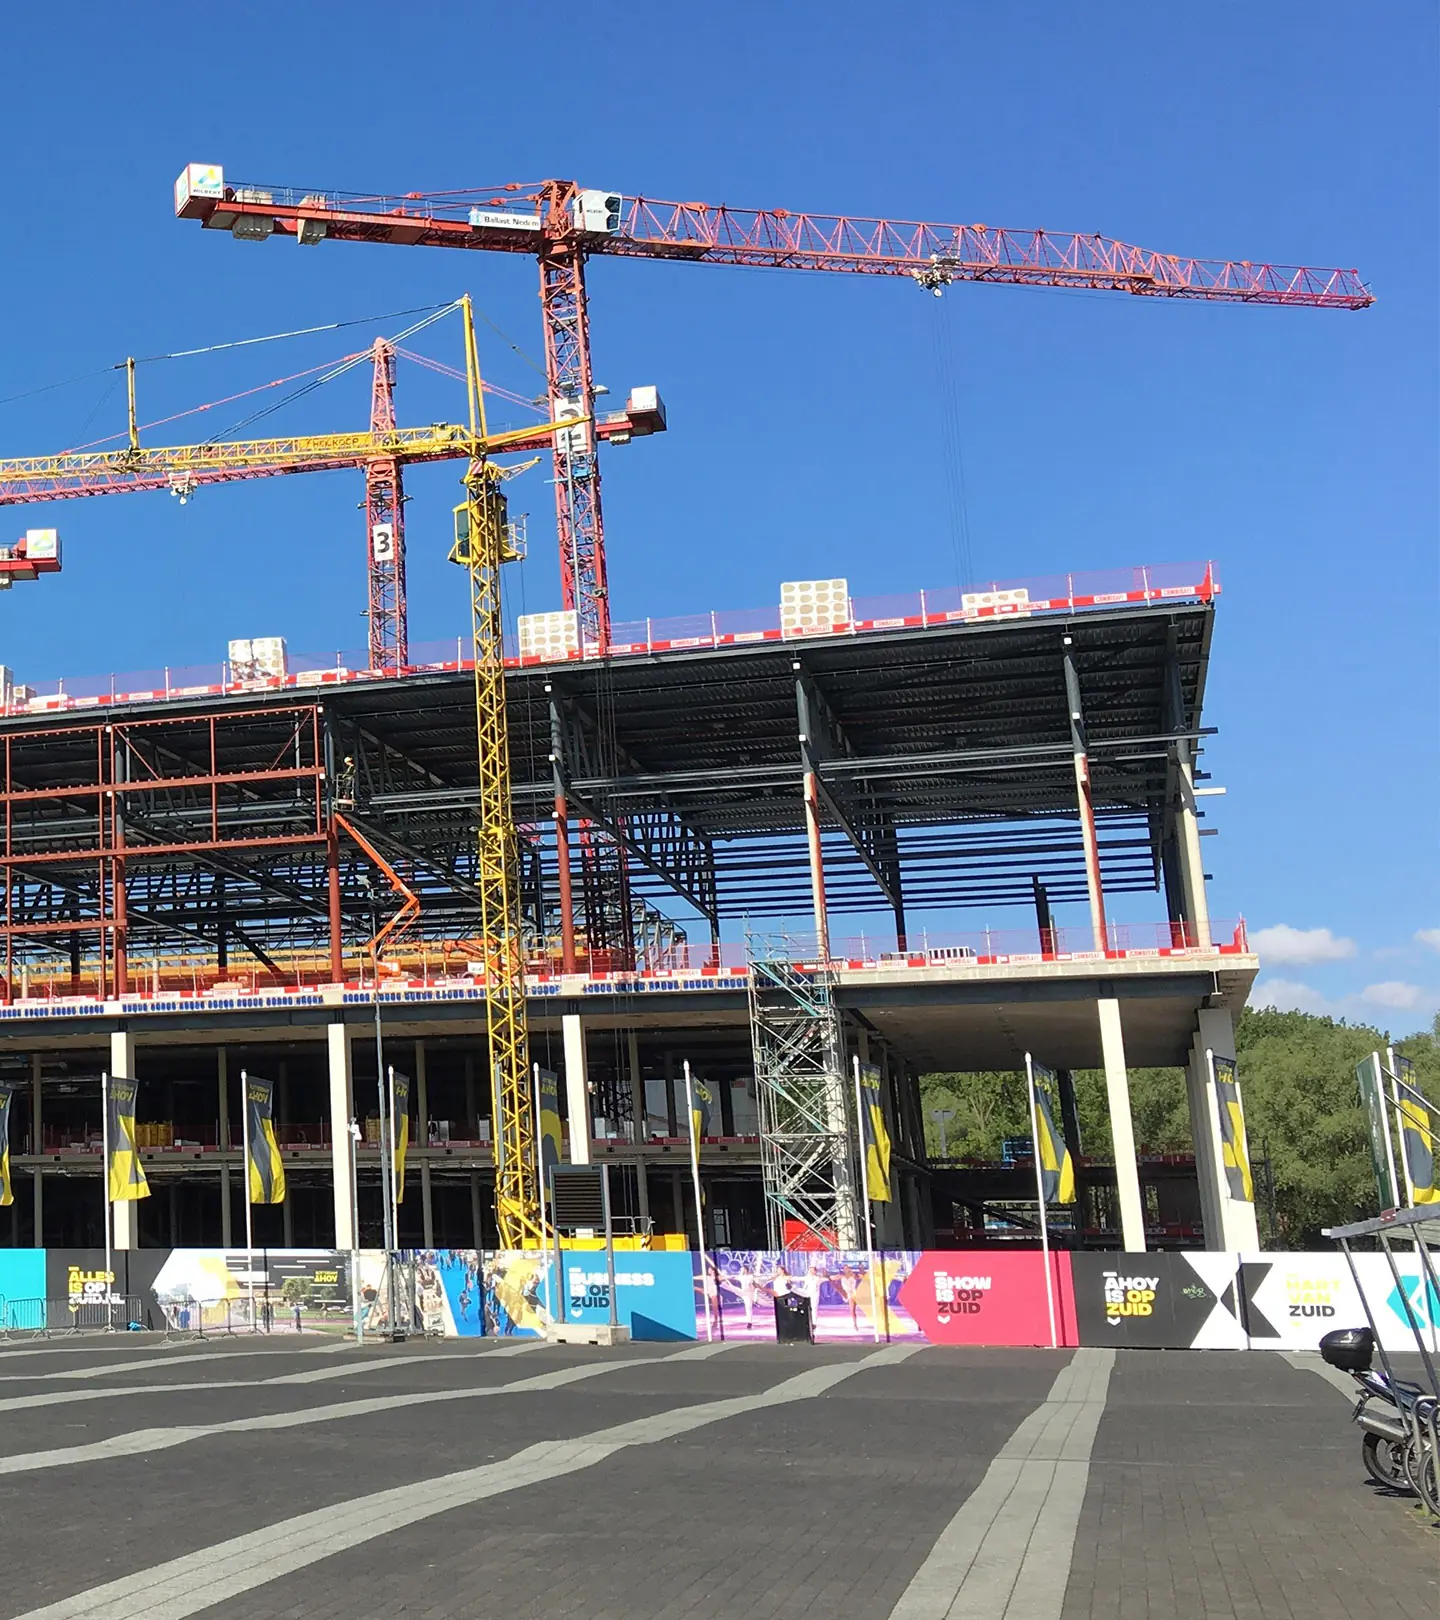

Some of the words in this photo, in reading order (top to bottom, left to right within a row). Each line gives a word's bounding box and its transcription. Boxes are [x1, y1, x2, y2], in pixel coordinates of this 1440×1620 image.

[484, 215, 510, 226] Ballast
[376, 531, 390, 554] 3
[69, 1271, 115, 1283] ALLES
[934, 1276, 991, 1289] SHOW
[69, 1282, 83, 1293] IS
[84, 1282, 106, 1293] OP
[1105, 1277, 1160, 1290] AHOY
[1286, 1279, 1341, 1291] HART
[936, 1289, 954, 1302] IS
[958, 1289, 983, 1302] OP
[1105, 1290, 1124, 1303] IS
[1127, 1290, 1155, 1303] OP
[1288, 1292, 1331, 1304] VAN
[571, 1296, 610, 1308] ZUID
[938, 1302, 981, 1314] ZUID
[1106, 1302, 1153, 1316] ZUID
[1288, 1305, 1336, 1317] ZUID
